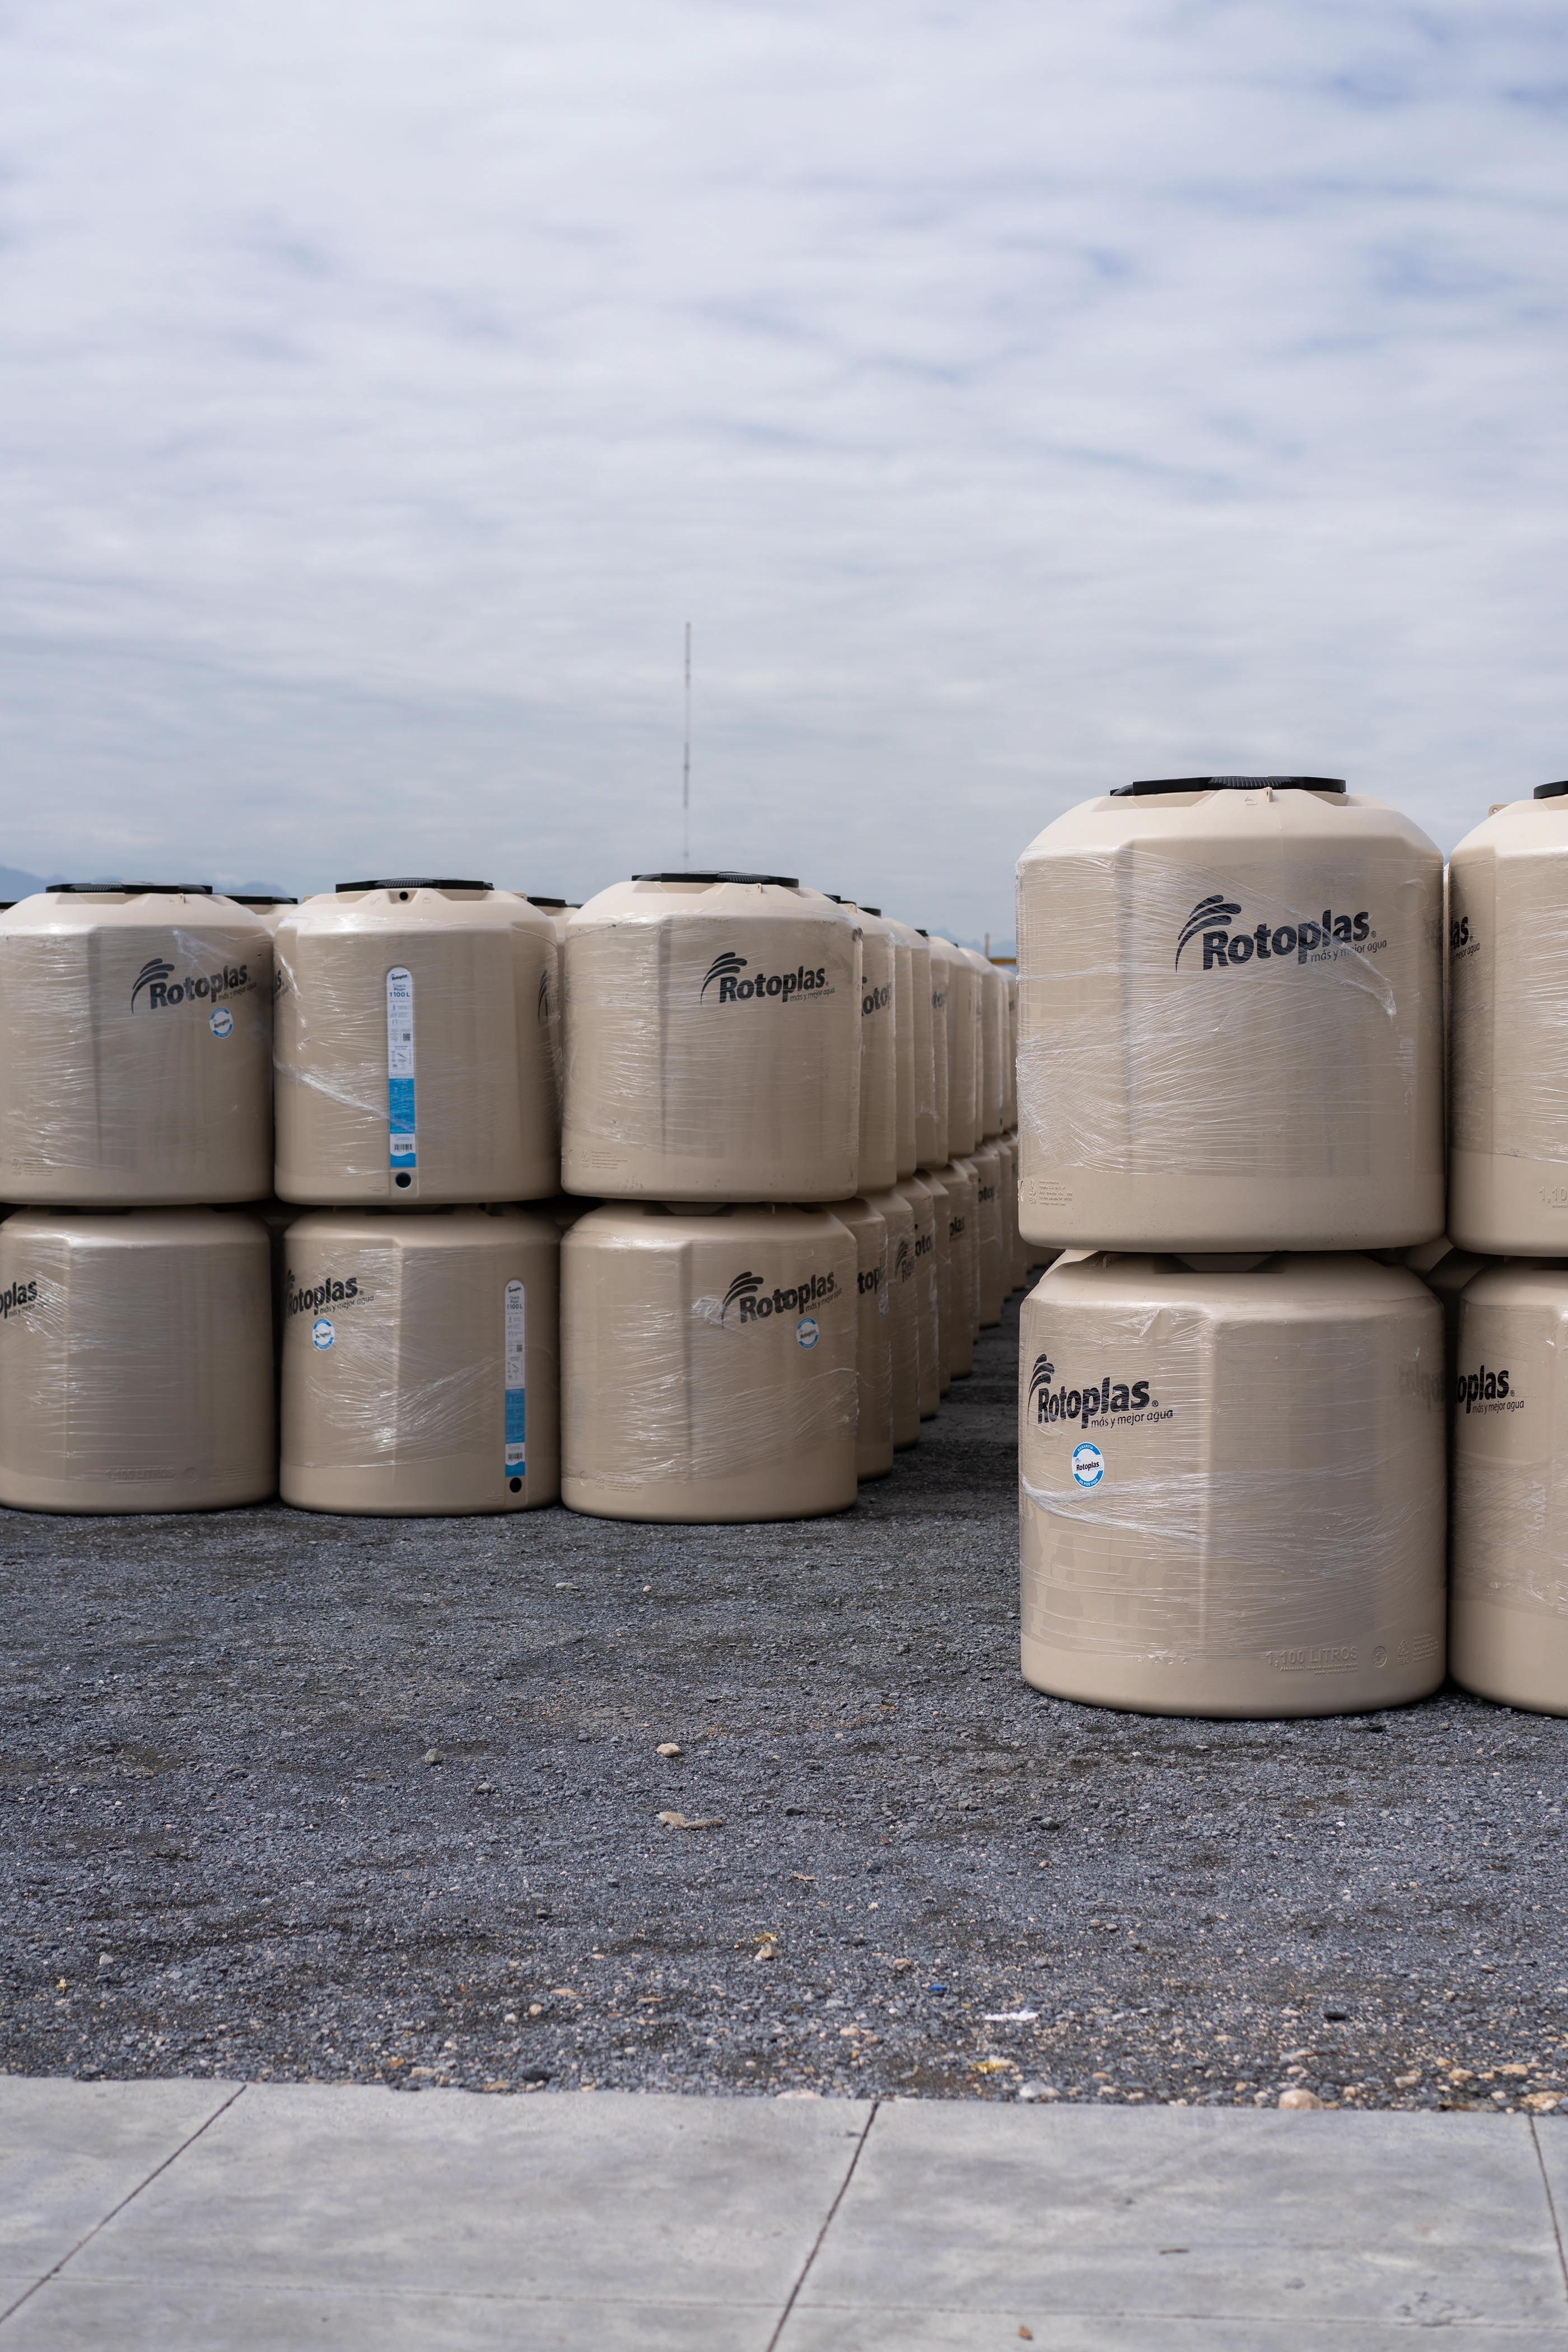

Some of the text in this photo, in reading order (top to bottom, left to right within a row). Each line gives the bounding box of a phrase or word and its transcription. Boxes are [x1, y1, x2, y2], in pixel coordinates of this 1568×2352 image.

[1203, 909, 1370, 970] Rotoplas
[1467, 943, 1480, 956] agua
[1311, 950, 1332, 963] más
[1333, 951, 1339, 962] y
[1367, 940, 1387, 953] agua
[150, 965, 248, 1009] Rotoplas
[233, 987, 246, 997] mejor
[720, 966, 825, 1003] Rotoplas
[790, 987, 835, 1001] más y mejor agua
[288, 1277, 358, 1317] Rotoplas
[320, 1305, 332, 1314] más
[337, 1300, 354, 1309] mejor
[357, 1296, 374, 1305] agua
[740, 1272, 834, 1324] Rotoplas
[806, 1303, 817, 1312] más
[817, 1301, 821, 1309] y
[821, 1295, 833, 1305] mejor
[1038, 1377, 1150, 1429] Rotoplas
[1472, 1401, 1524, 1415] más y mejor agua
[1091, 1410, 1173, 1429] más y mejor agua
[1076, 1462, 1099, 1471] Rotoplas
[1266, 1646, 1358, 1667] 1,100 LITROS
